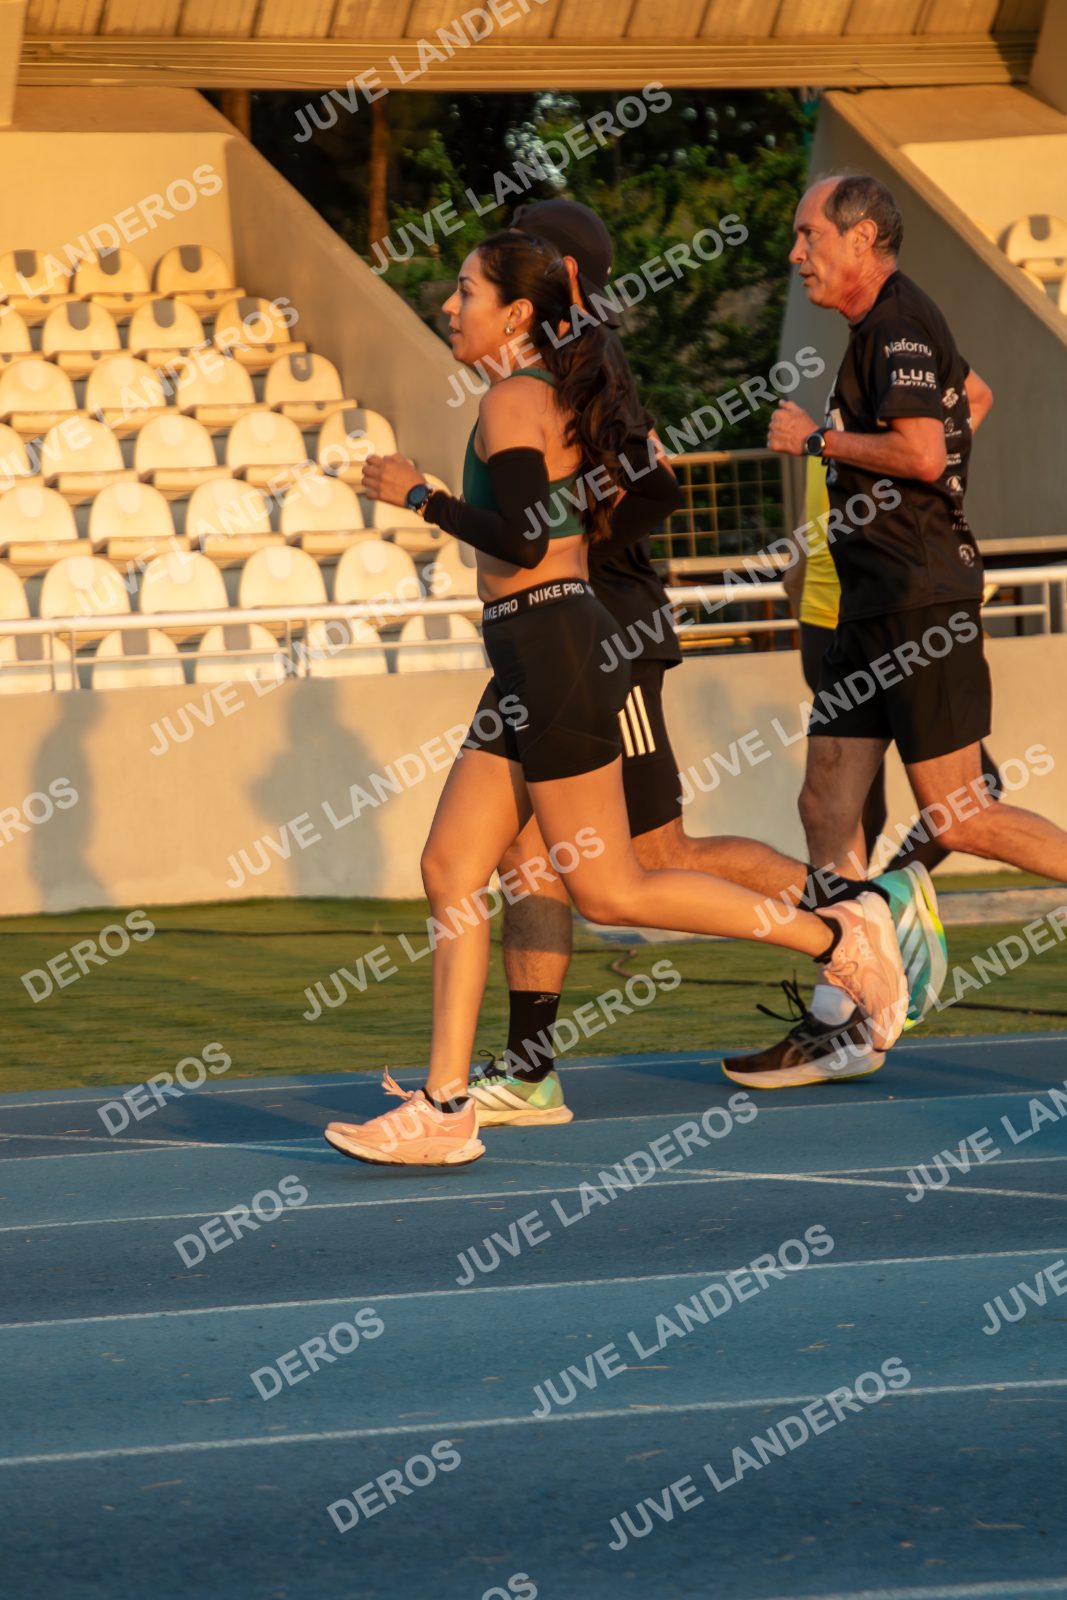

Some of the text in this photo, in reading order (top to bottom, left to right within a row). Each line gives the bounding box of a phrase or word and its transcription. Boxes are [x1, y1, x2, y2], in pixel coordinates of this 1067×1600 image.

[528, 584, 562, 606] NIKE
[563, 582, 585, 597] PRO
[498, 599, 519, 617] PRO
